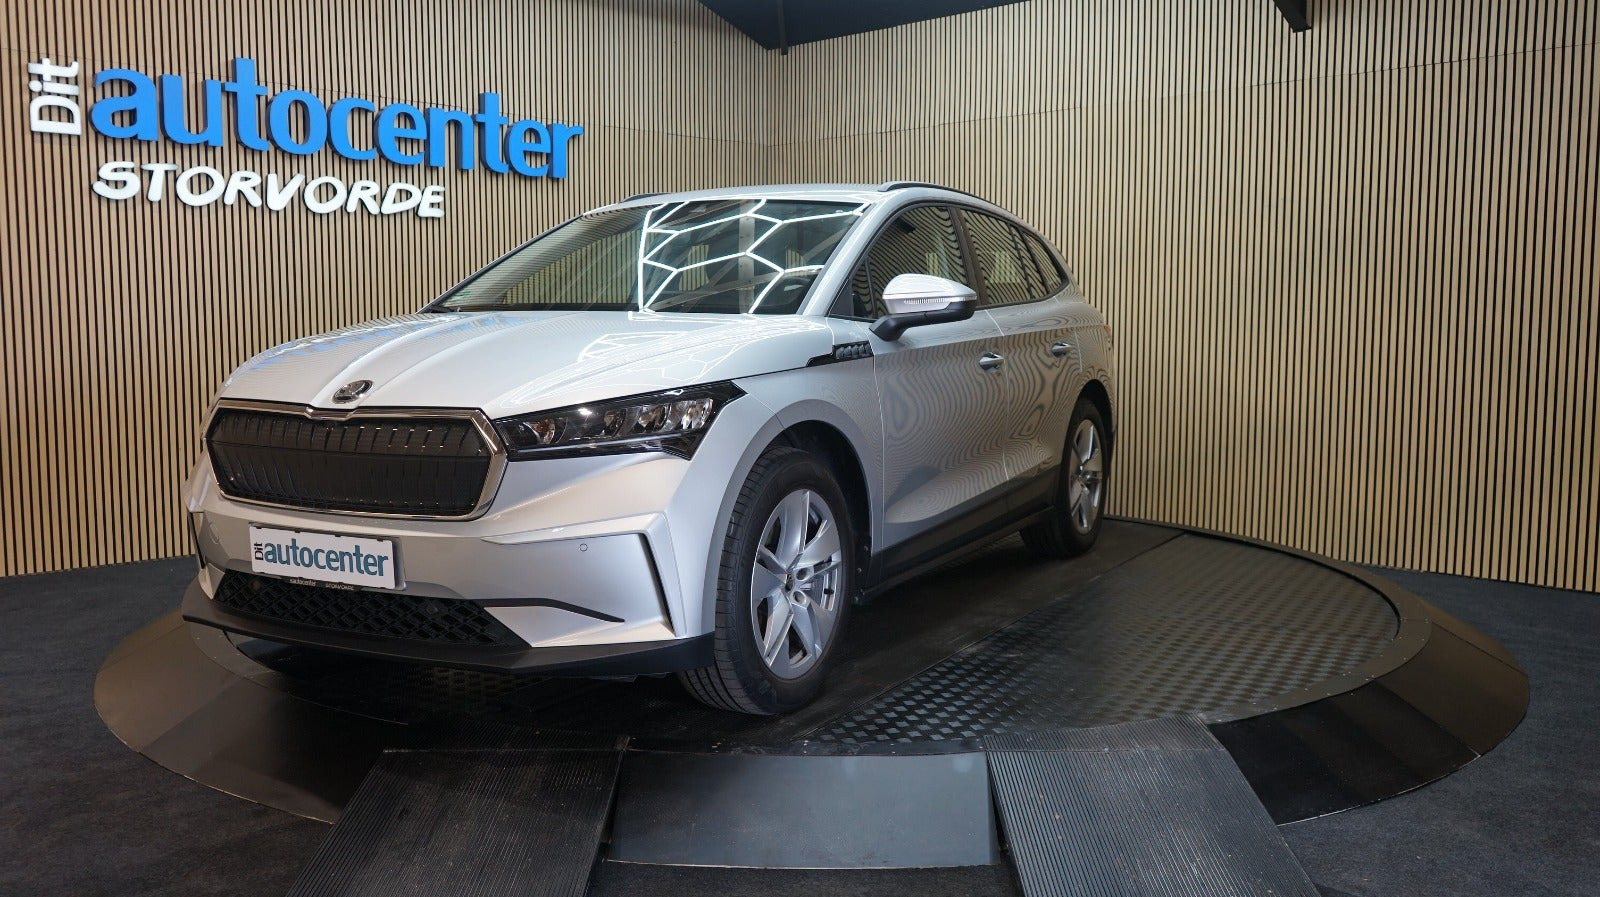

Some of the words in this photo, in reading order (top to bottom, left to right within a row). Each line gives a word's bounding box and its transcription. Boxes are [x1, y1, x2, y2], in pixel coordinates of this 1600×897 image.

[28, 57, 81, 135] Dit
[91, 57, 583, 180] autocenter
[92, 161, 445, 218] STORVORDE
[254, 541, 264, 561] Dit
[264, 538, 389, 577] autocenter
